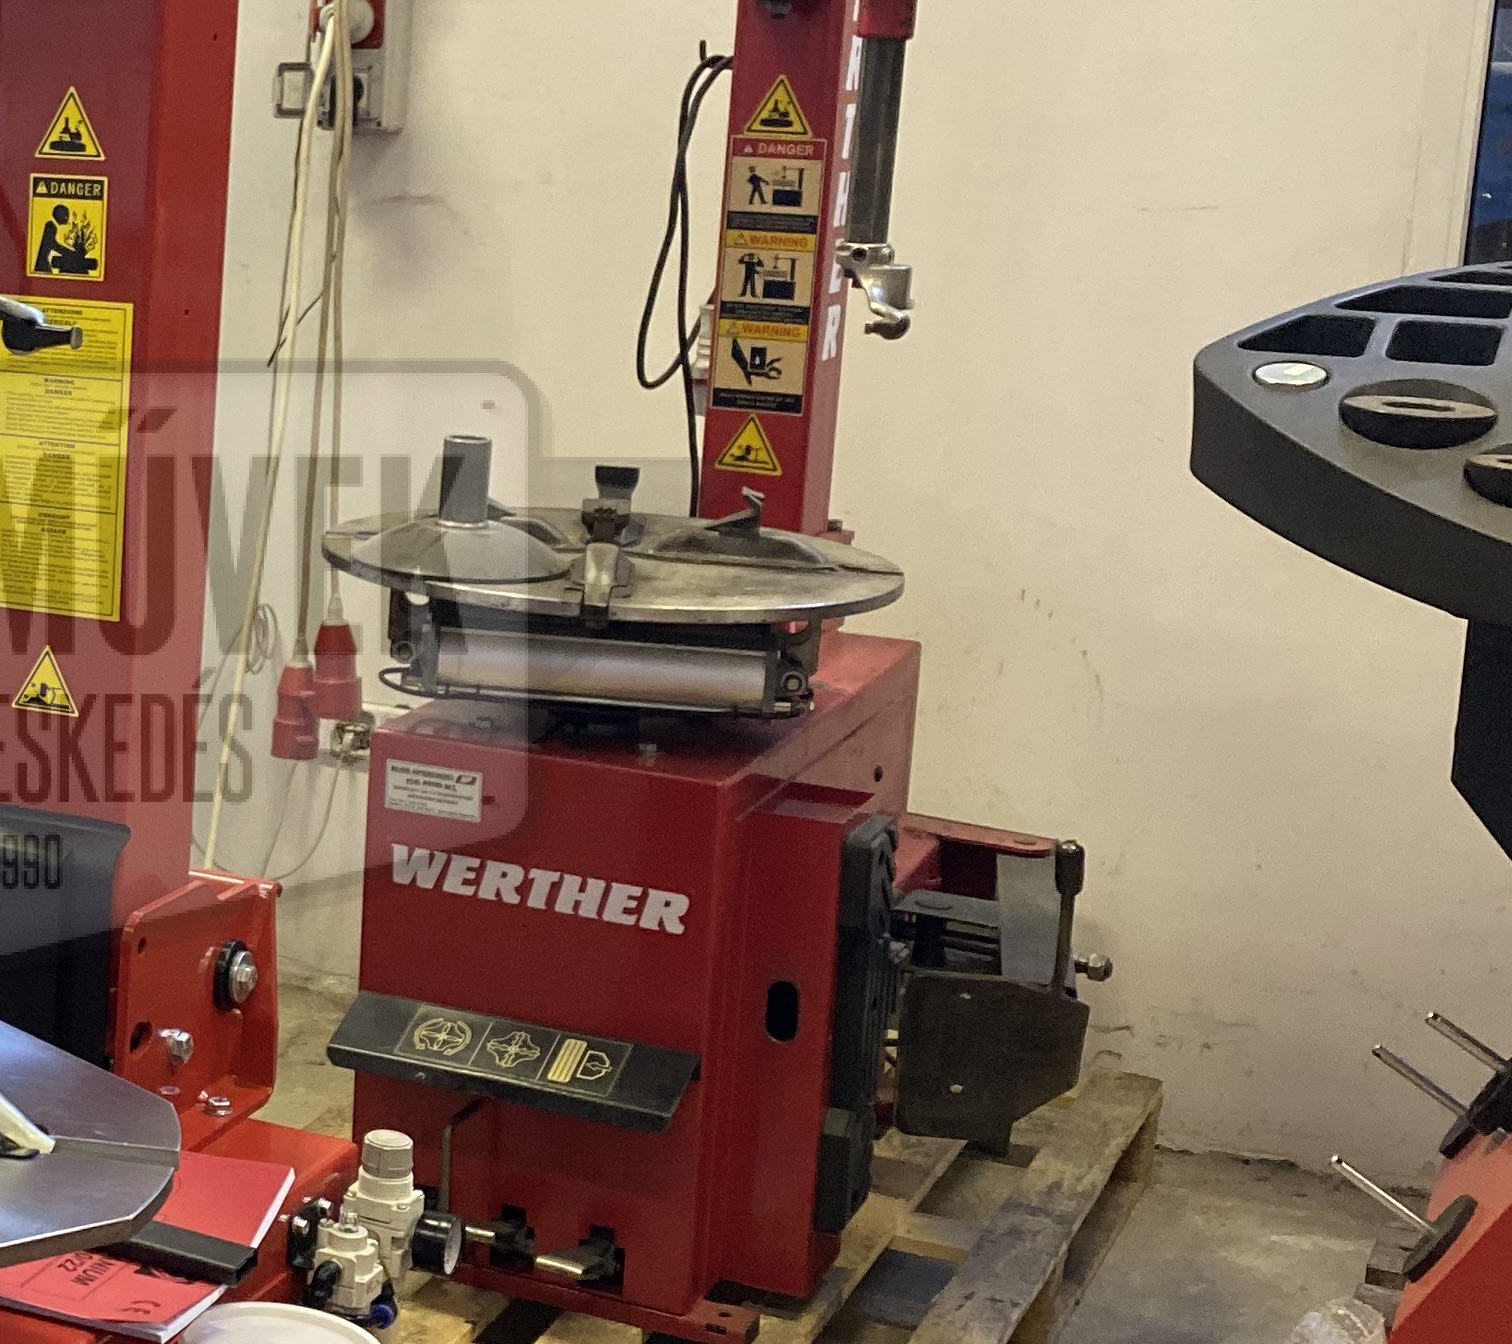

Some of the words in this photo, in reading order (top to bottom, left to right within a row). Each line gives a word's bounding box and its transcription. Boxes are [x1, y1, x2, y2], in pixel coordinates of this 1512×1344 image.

[758, 143, 814, 156] DANGER
[50, 181, 101, 197] DANGER
[750, 234, 808, 248] WARNING
[743, 323, 801, 338] WARNING
[391, 842, 690, 935] WERTHER
